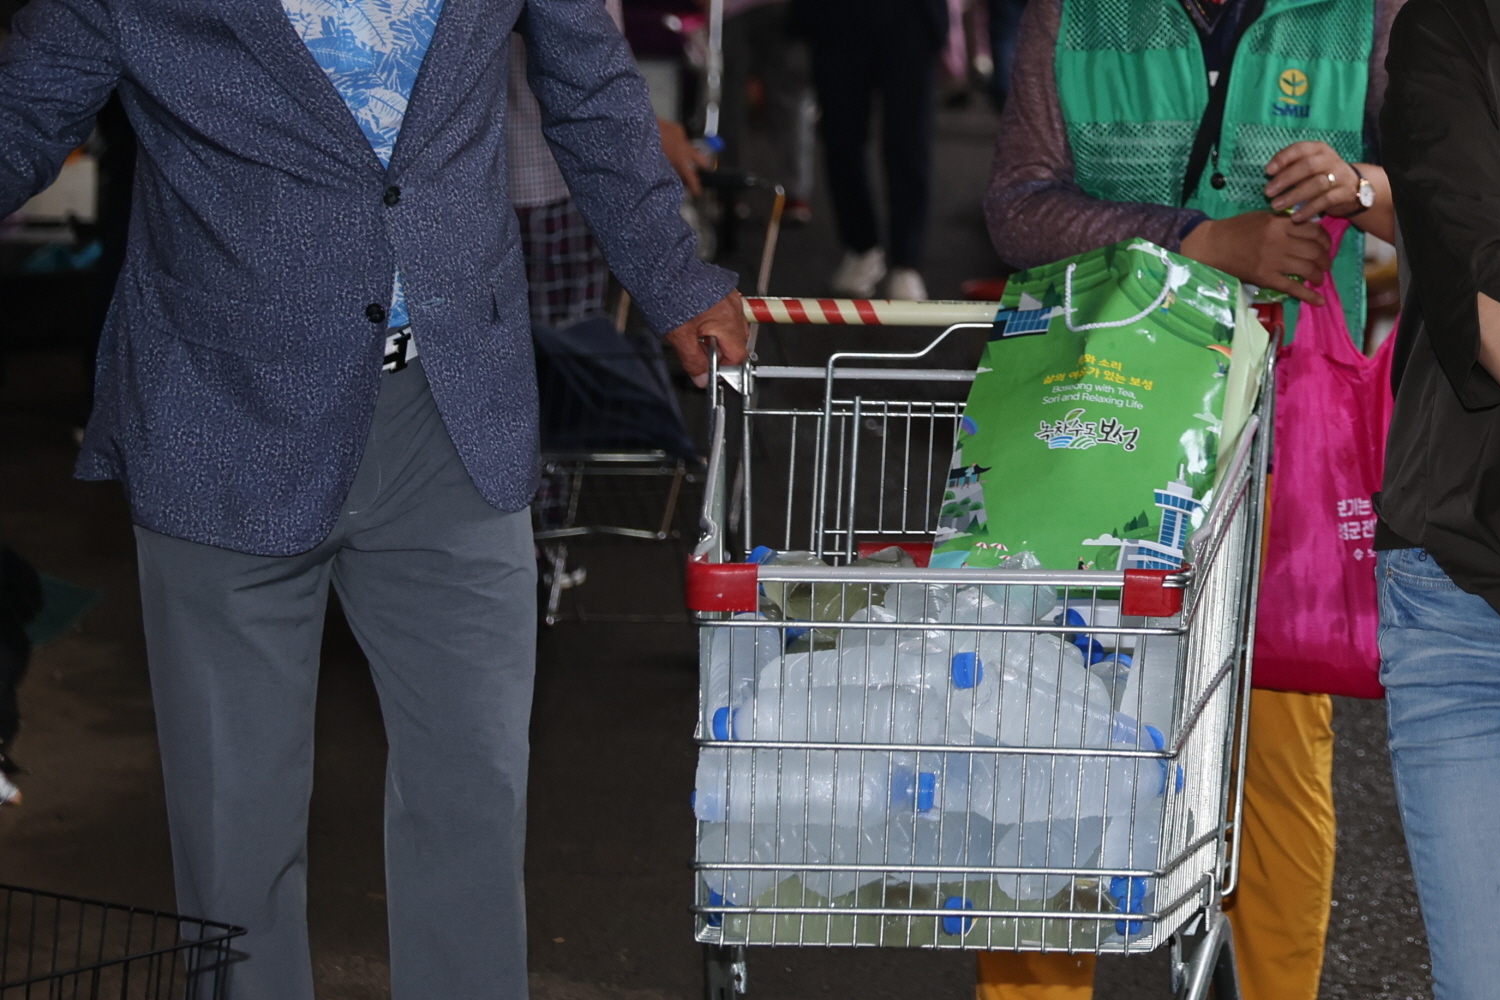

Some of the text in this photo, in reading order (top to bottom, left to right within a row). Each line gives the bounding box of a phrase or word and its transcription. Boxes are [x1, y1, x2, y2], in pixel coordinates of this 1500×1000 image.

[1098, 358, 1123, 371] 소리
[1103, 370, 1127, 385] 있는
[1128, 376, 1154, 391] 보성
[1094, 384, 1115, 394] with
[1117, 386, 1137, 399] Tea,
[1042, 392, 1144, 410] Sori and Relaxing Life
[1035, 417, 1140, 452] 녹차수도 보성
